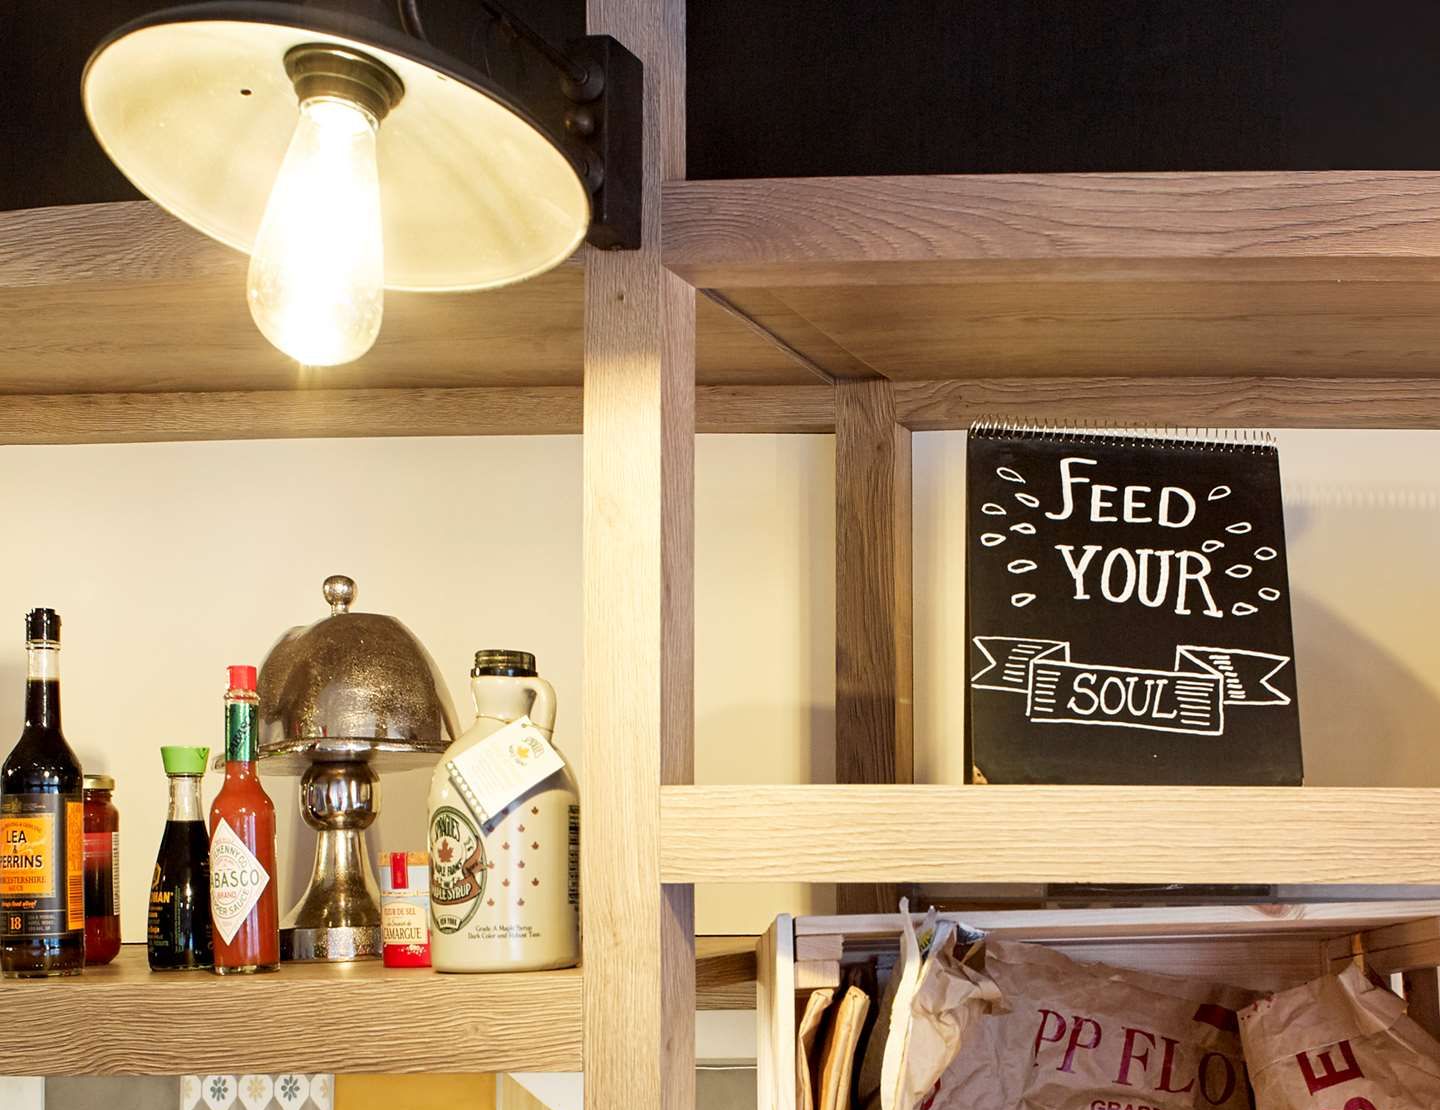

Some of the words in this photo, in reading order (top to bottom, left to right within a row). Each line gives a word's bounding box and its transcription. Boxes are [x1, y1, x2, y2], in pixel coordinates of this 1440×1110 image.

[1045, 457, 1197, 528] FEED
[1054, 544, 1224, 618] YOUR
[1066, 672, 1178, 719] SOUL
[6, 831, 28, 843] LEA
[9, 917, 22, 931] 18
